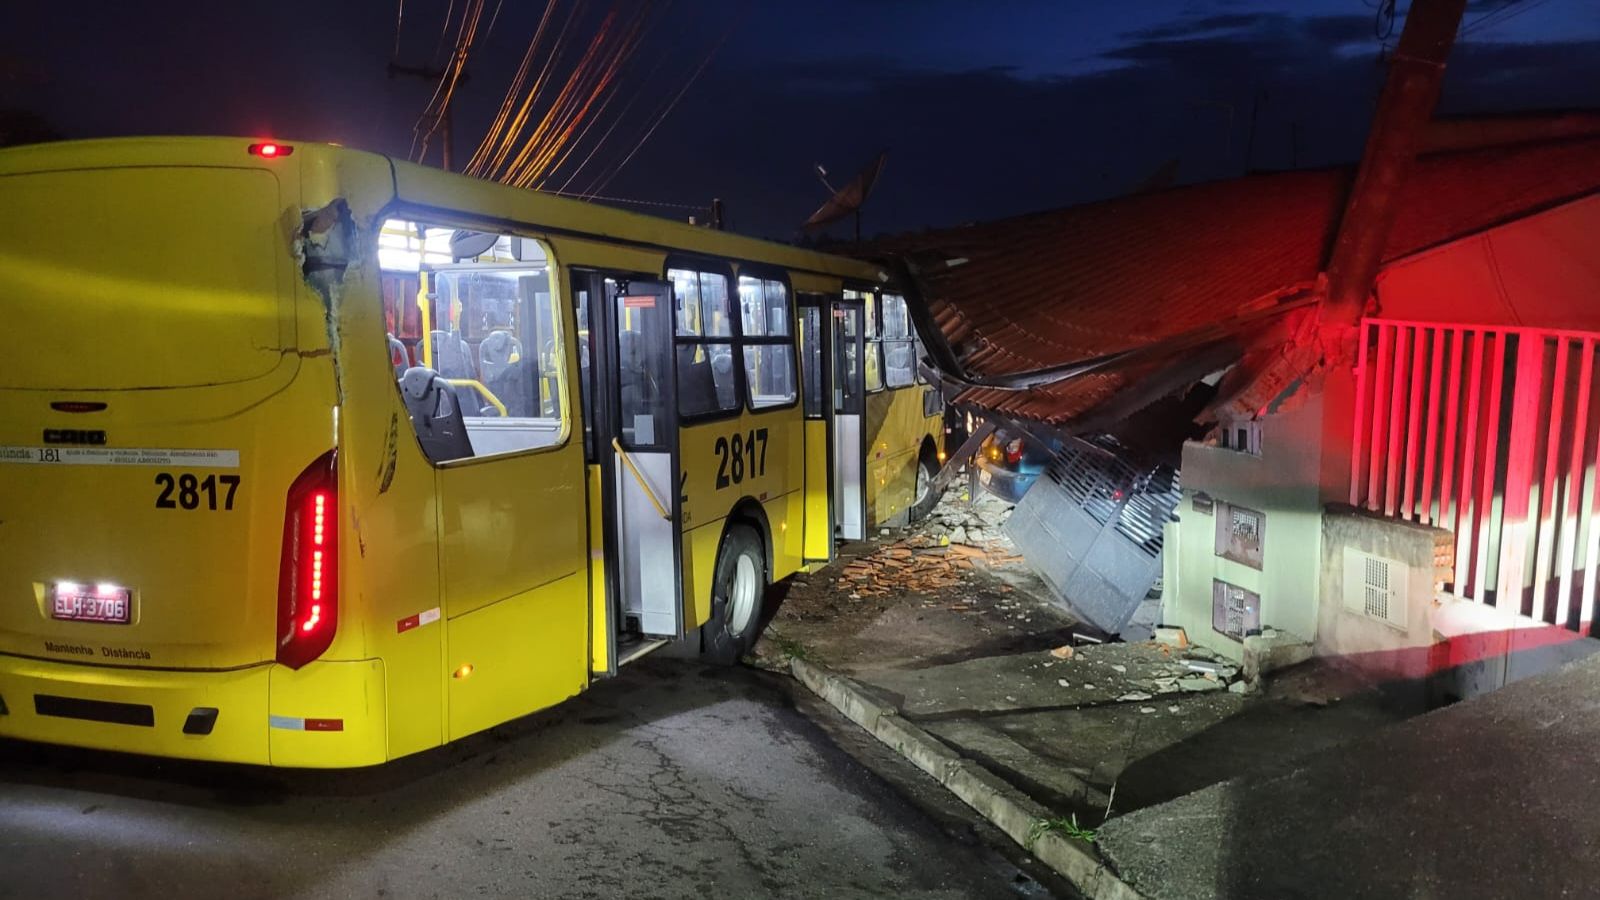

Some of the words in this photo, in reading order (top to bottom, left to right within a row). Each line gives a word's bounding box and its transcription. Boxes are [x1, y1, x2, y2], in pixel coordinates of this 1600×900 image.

[38, 448, 61, 462] 181
[714, 428, 769, 490] 2817
[155, 472, 241, 511] 2817
[44, 641, 94, 656] Mantenha
[101, 645, 151, 660] Distância
